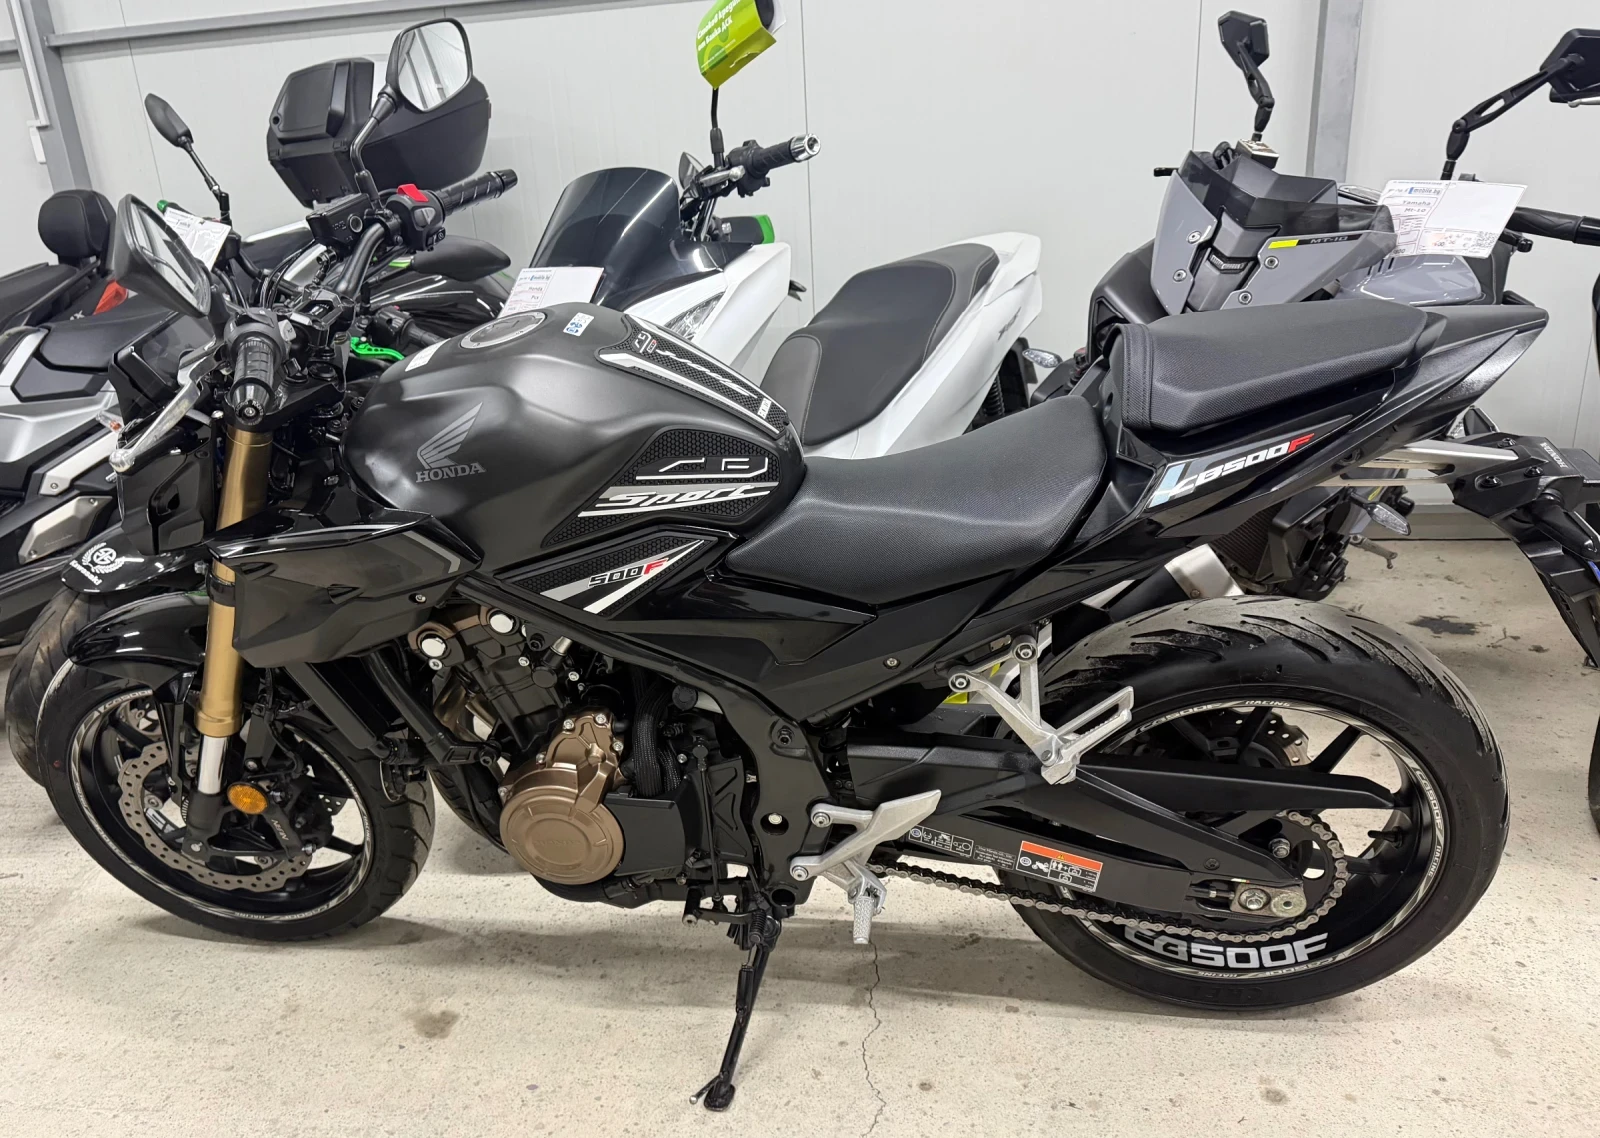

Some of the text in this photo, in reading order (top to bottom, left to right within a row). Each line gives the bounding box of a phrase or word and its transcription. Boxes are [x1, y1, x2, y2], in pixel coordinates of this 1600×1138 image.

[1310, 236, 1349, 244] MT-10
[415, 462, 487, 483] HONDA
[69, 560, 102, 585] Kawasaki
[589, 558, 669, 587] 500F
[1245, 699, 1291, 707] RACING
[1415, 769, 1444, 877] CB500F RACING
[1124, 926, 1328, 969] CB500F
